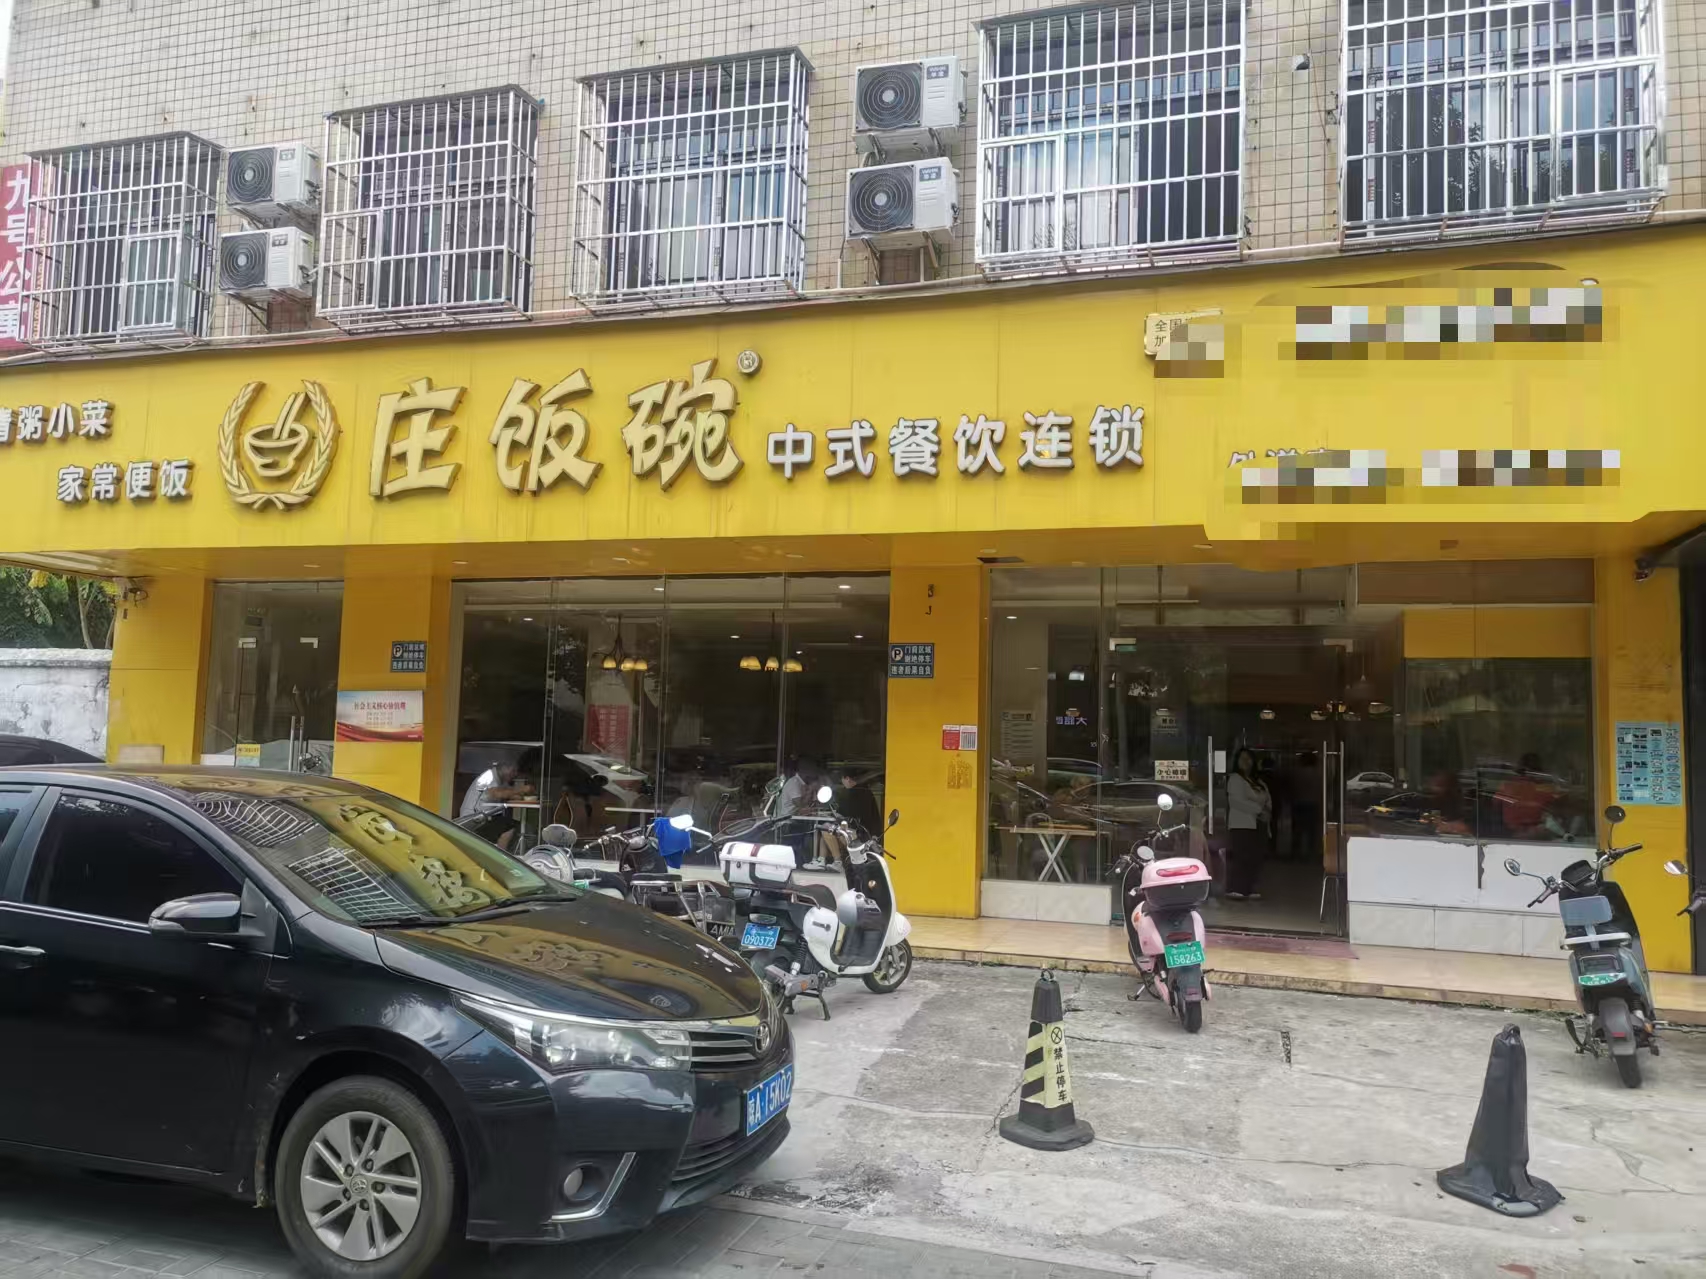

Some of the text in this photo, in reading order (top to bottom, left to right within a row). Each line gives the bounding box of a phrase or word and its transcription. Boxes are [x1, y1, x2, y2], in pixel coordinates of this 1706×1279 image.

[369, 358, 744, 498] 庄饭碗
[766, 404, 1145, 480] 中式餐饮连锁
[56, 459, 194, 503] 家常便饭
[744, 934, 775, 947] 090372
[1169, 951, 1202, 966] 158263
[1053, 1047, 1067, 1101] 禁止停车
